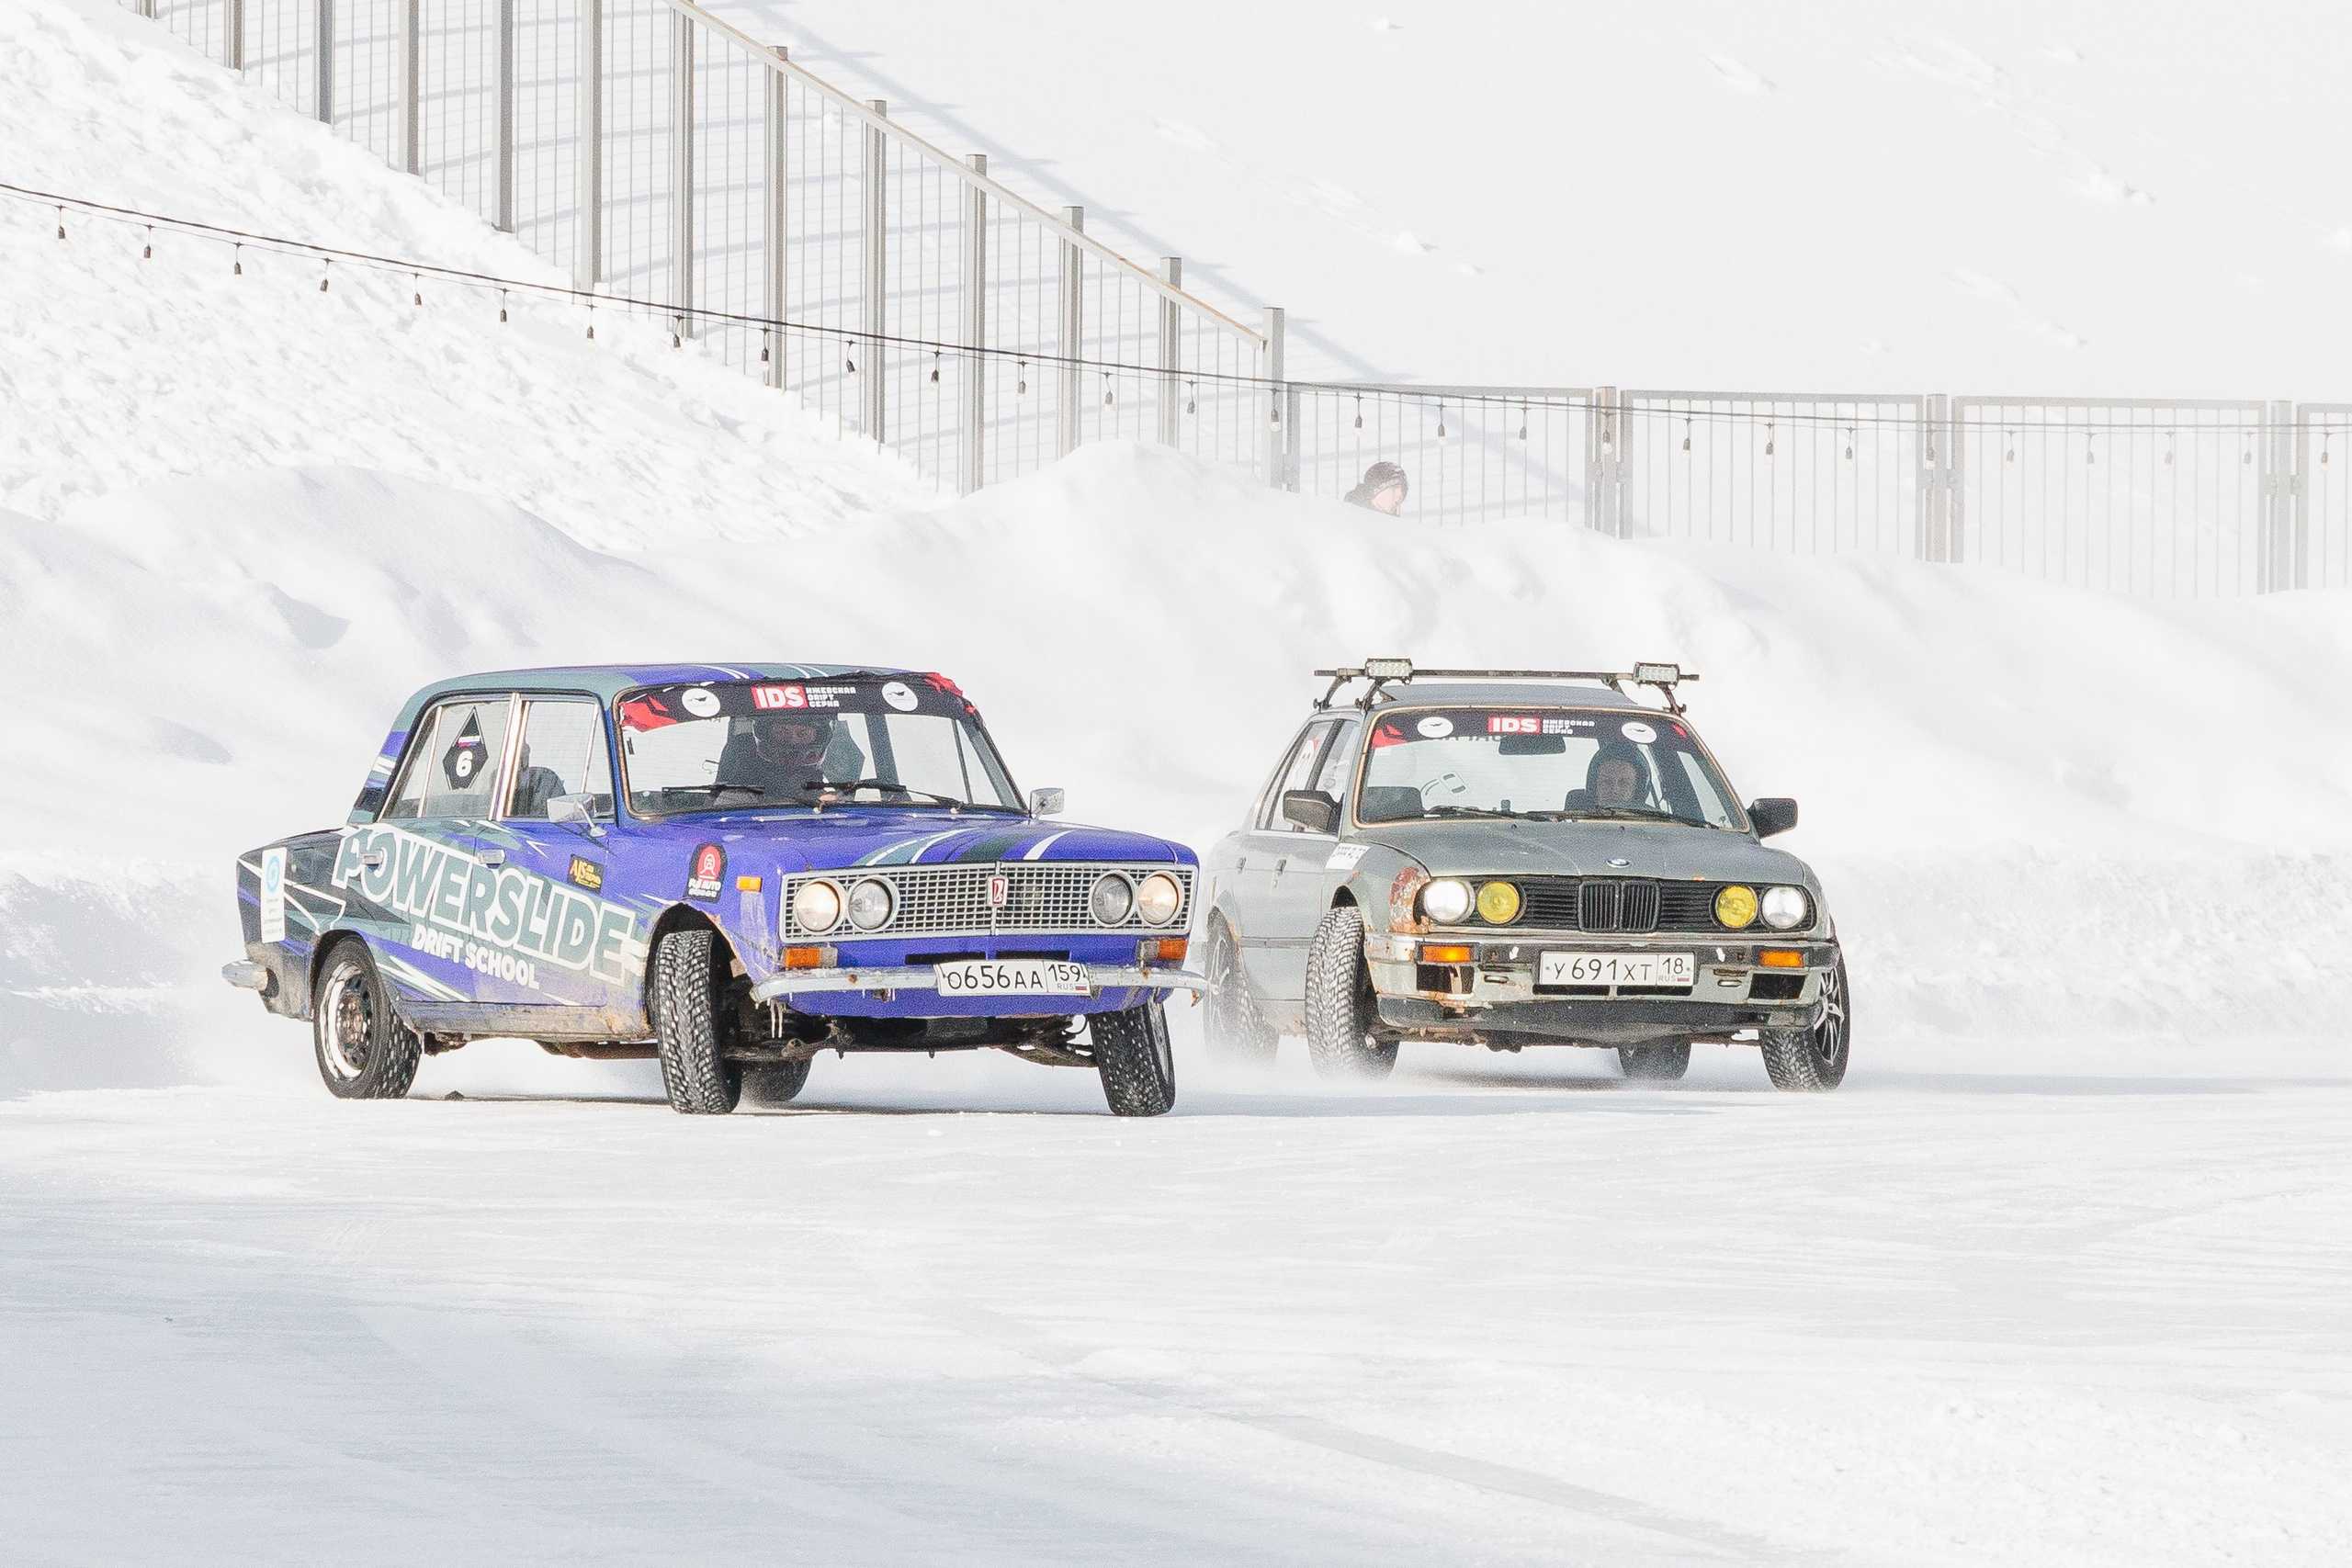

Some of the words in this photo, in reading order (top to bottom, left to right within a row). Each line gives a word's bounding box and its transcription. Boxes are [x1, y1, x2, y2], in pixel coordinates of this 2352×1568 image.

[756, 687, 804, 708] IDS
[1492, 717, 1538, 733] IDS
[456, 750, 473, 777] 6
[331, 825, 637, 987] POWERSLIDE
[412, 922, 464, 964] DRIFT
[465, 943, 540, 990] SCHOOL
[1661, 957, 1684, 975] 18
[1047, 964, 1080, 982] 159
